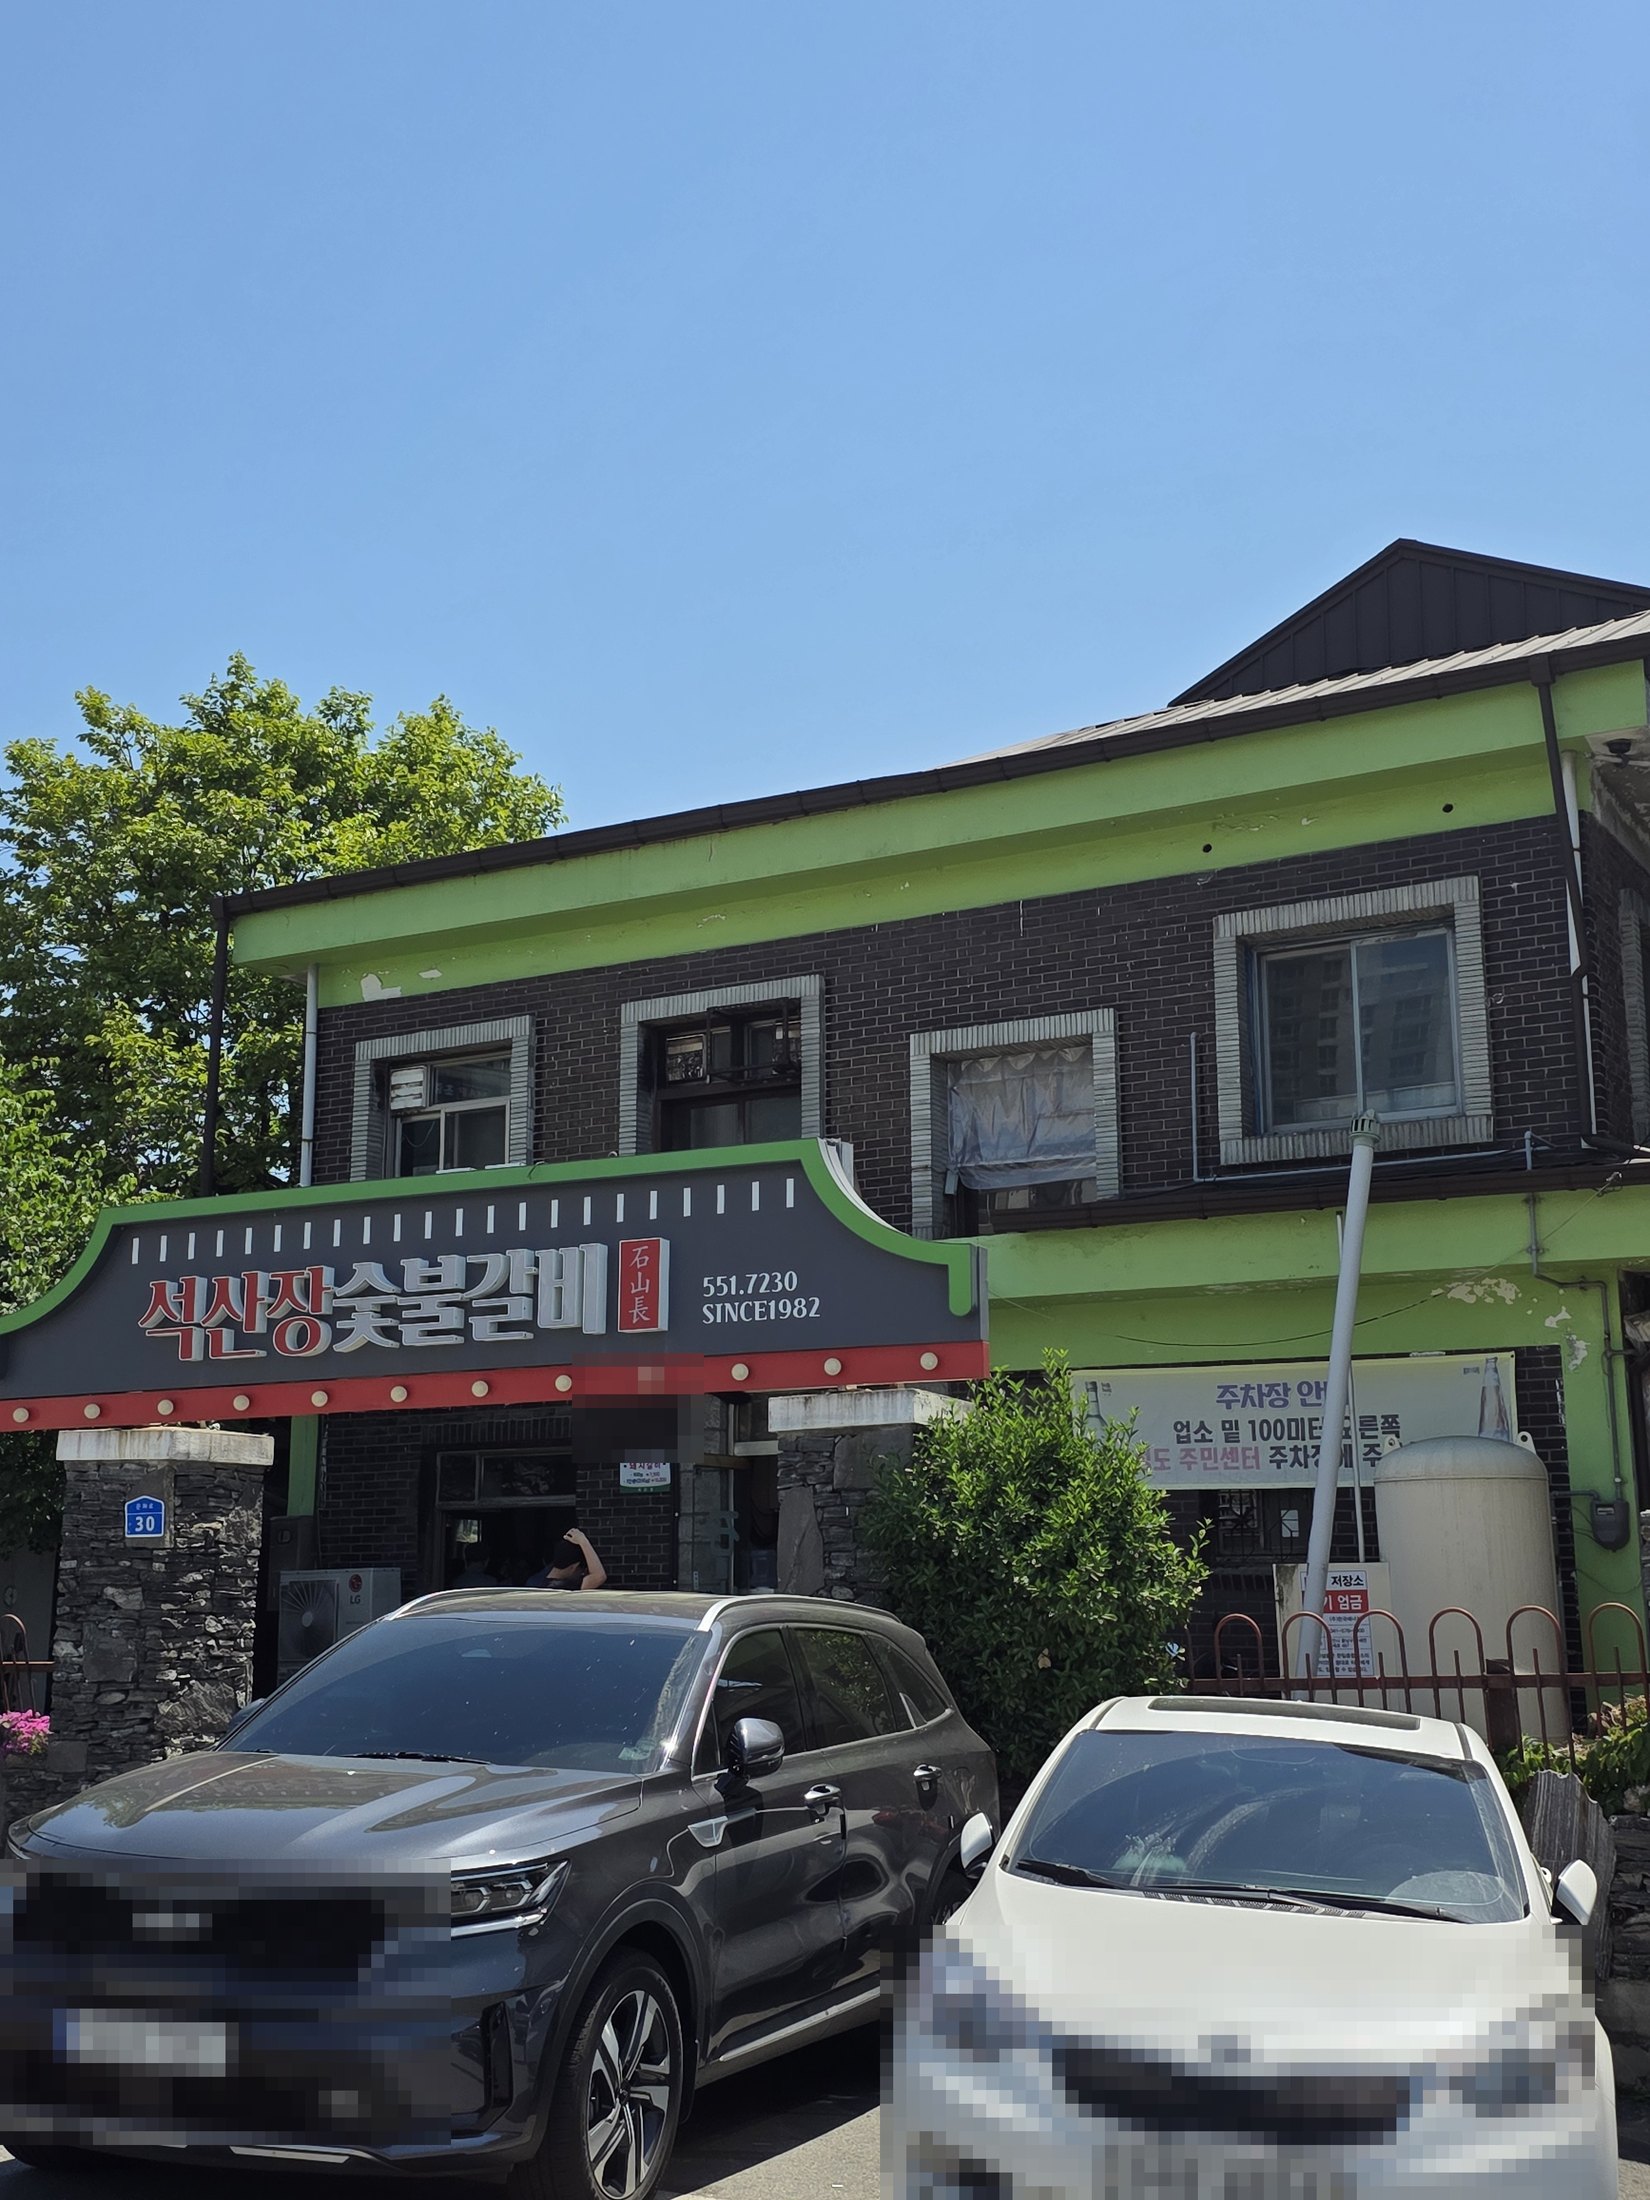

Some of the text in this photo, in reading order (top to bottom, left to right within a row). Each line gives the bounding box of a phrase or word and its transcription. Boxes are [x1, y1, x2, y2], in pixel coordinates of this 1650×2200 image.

[702, 1270, 798, 1297] 551.7230
[1216, 1380, 1329, 1410] 주차장 안
[1173, 1420, 1213, 1444] 업소
[1221, 1419, 1241, 1443] 밑
[1179, 1446, 1261, 1471] 주민센터
[135, 1516, 155, 1532] 30
[1331, 1575, 1364, 1587] 저장소
[350, 1595, 361, 1604] LG
[1338, 1594, 1362, 1610] 엄금
